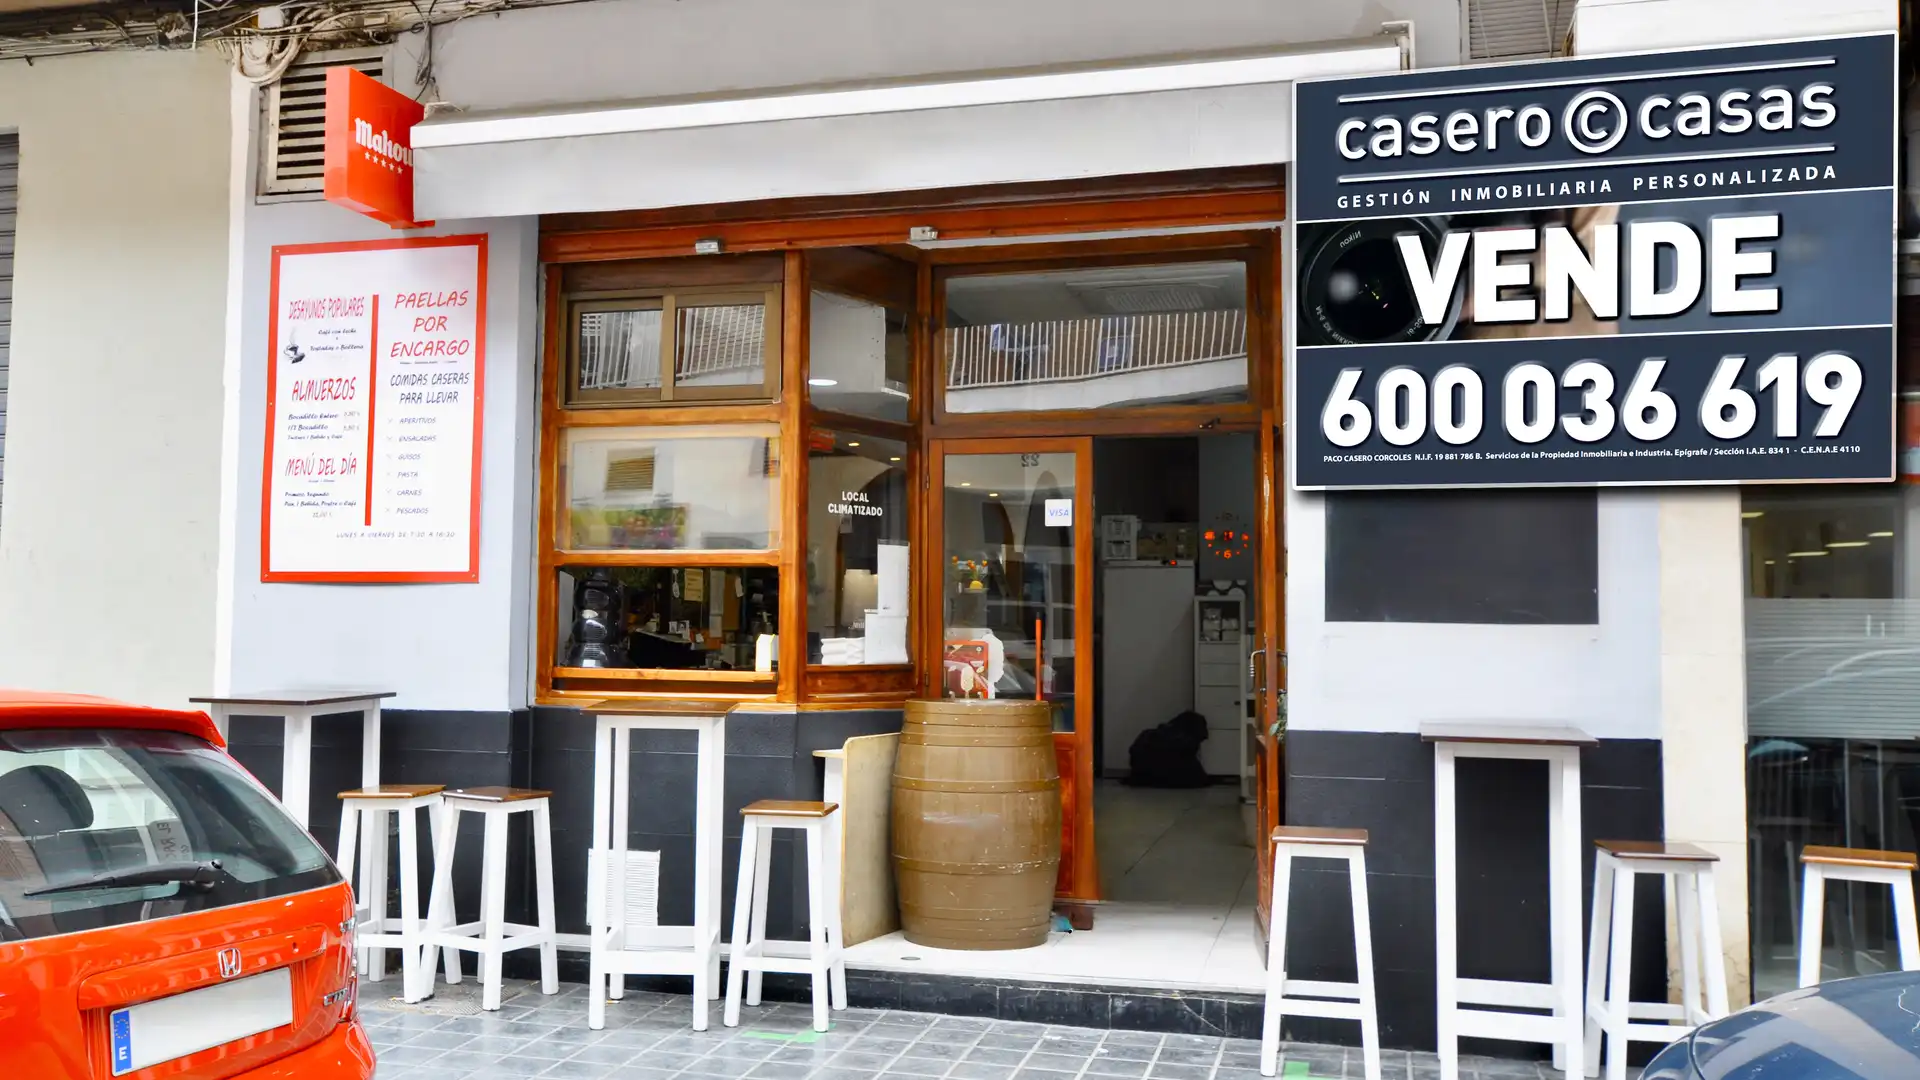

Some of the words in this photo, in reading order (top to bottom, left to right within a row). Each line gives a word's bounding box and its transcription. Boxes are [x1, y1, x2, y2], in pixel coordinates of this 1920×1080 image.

[1337, 103, 1551, 161] casero
[1638, 81, 1837, 139] casas
[1337, 188, 1433, 209] GESTIÓN
[1451, 176, 1613, 202] INMOBILIARIA
[1633, 164, 1838, 192] PERSONALIZADA
[1396, 213, 1781, 326] VENDE
[289, 299, 326, 320] DESAYUNOS
[328, 297, 365, 318] POPULARES
[394, 290, 469, 309] PAELLAS
[413, 315, 448, 333] POR
[390, 339, 470, 358] ENCARGO
[291, 376, 357, 402] ALMUERZOS
[390, 373, 429, 387] COMIDAS
[431, 372, 470, 386] CASERAS
[399, 391, 423, 405] PARA
[426, 390, 459, 404] LLEVAR
[1320, 366, 1483, 447] 600
[1503, 359, 1677, 443] 036
[1698, 353, 1863, 439] 619
[1323, 455, 1343, 463] PACO
[1344, 455, 1373, 463] CASERO
[1374, 454, 1412, 462] CORCOLES
[1485, 452, 1519, 460] Servicios
[1540, 451, 1579, 460] Propiedad
[1580, 450, 1628, 458] Inmobiliaria
[1674, 448, 1708, 458] Epígrafe
[1714, 447, 1745, 456] Sección
[1768, 447, 1784, 455] 834
[1839, 445, 1861, 453] 4110
[284, 451, 315, 477] MENÚ
[318, 458, 337, 476] DEL
[340, 451, 357, 475] DÍA
[842, 491, 870, 503] LOCAL
[827, 502, 883, 517] CLIMATIZADO
[1049, 508, 1069, 517] VISA
[118, 1046, 128, 1061] E
